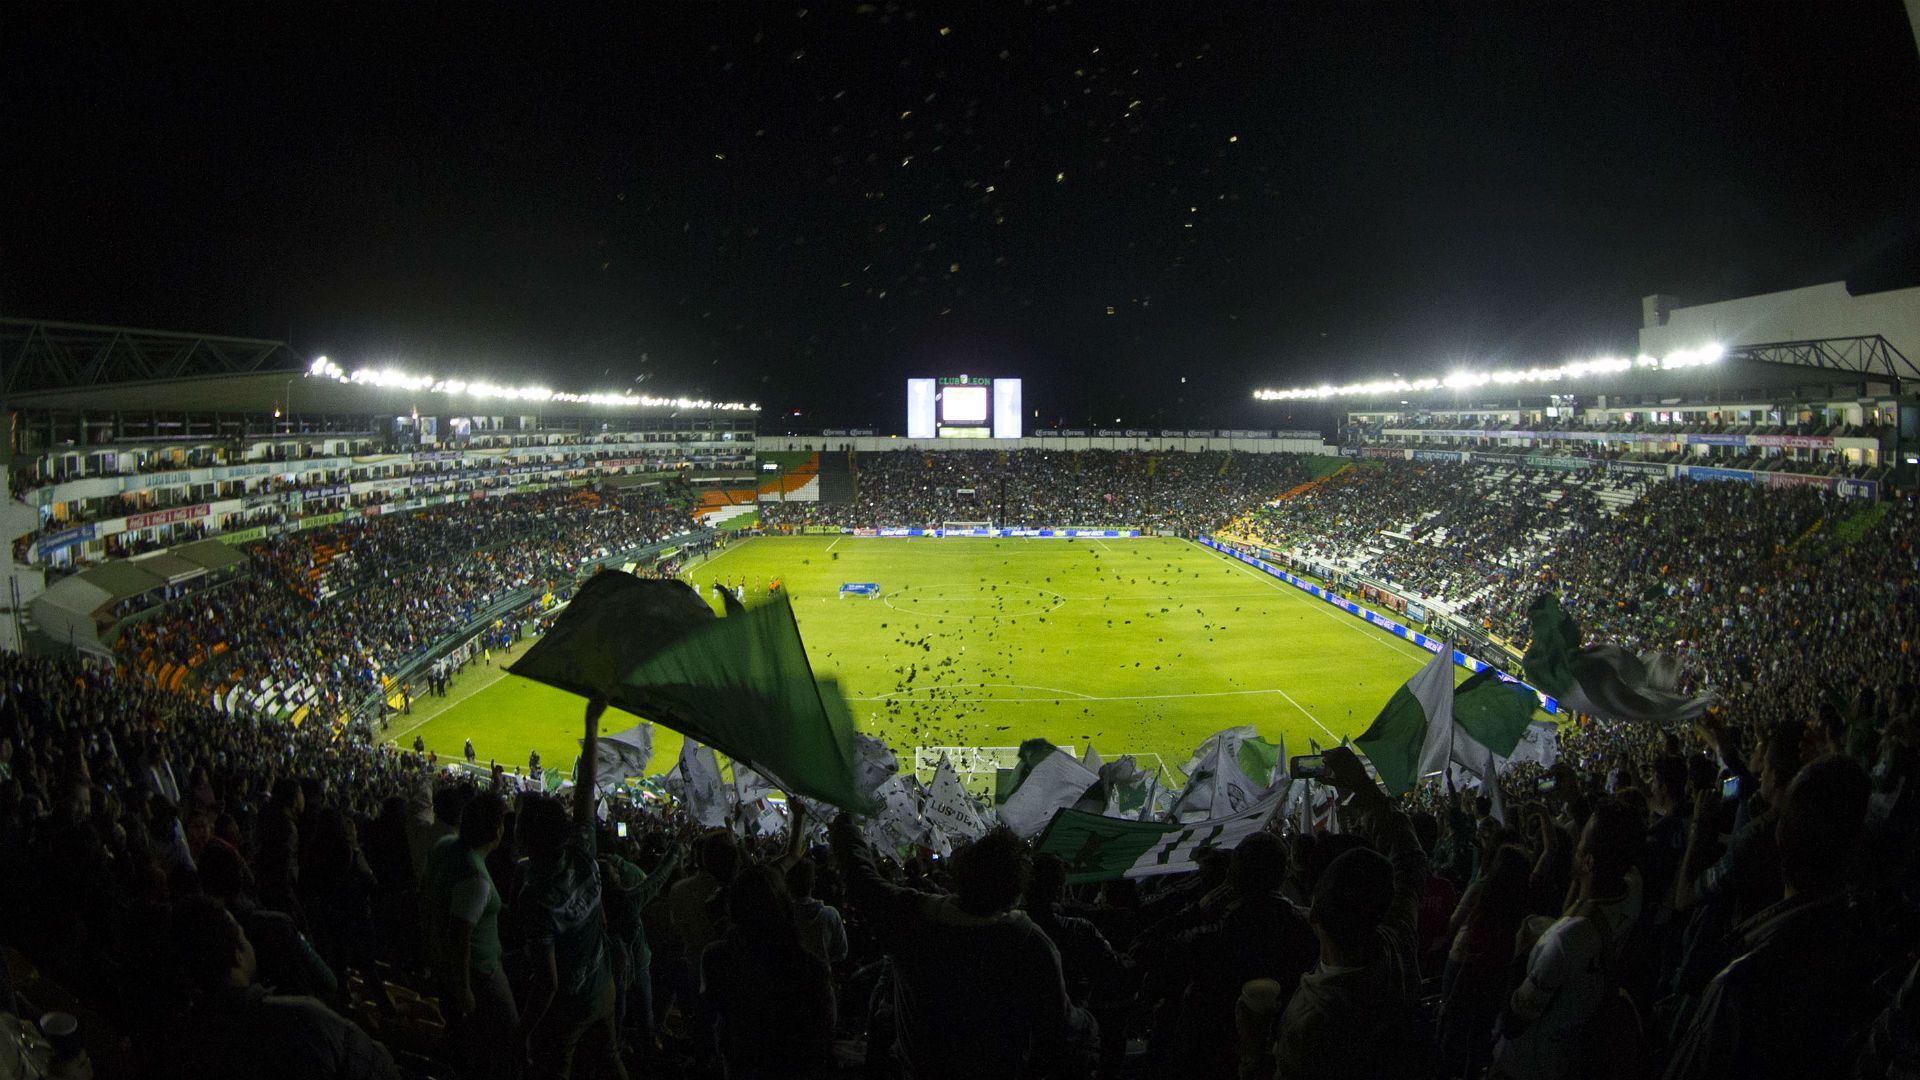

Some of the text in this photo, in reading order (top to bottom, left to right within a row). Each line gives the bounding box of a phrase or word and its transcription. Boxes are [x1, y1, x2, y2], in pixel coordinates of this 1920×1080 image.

[939, 377, 960, 385] CLUB
[930, 799, 972, 826] LOS DE
